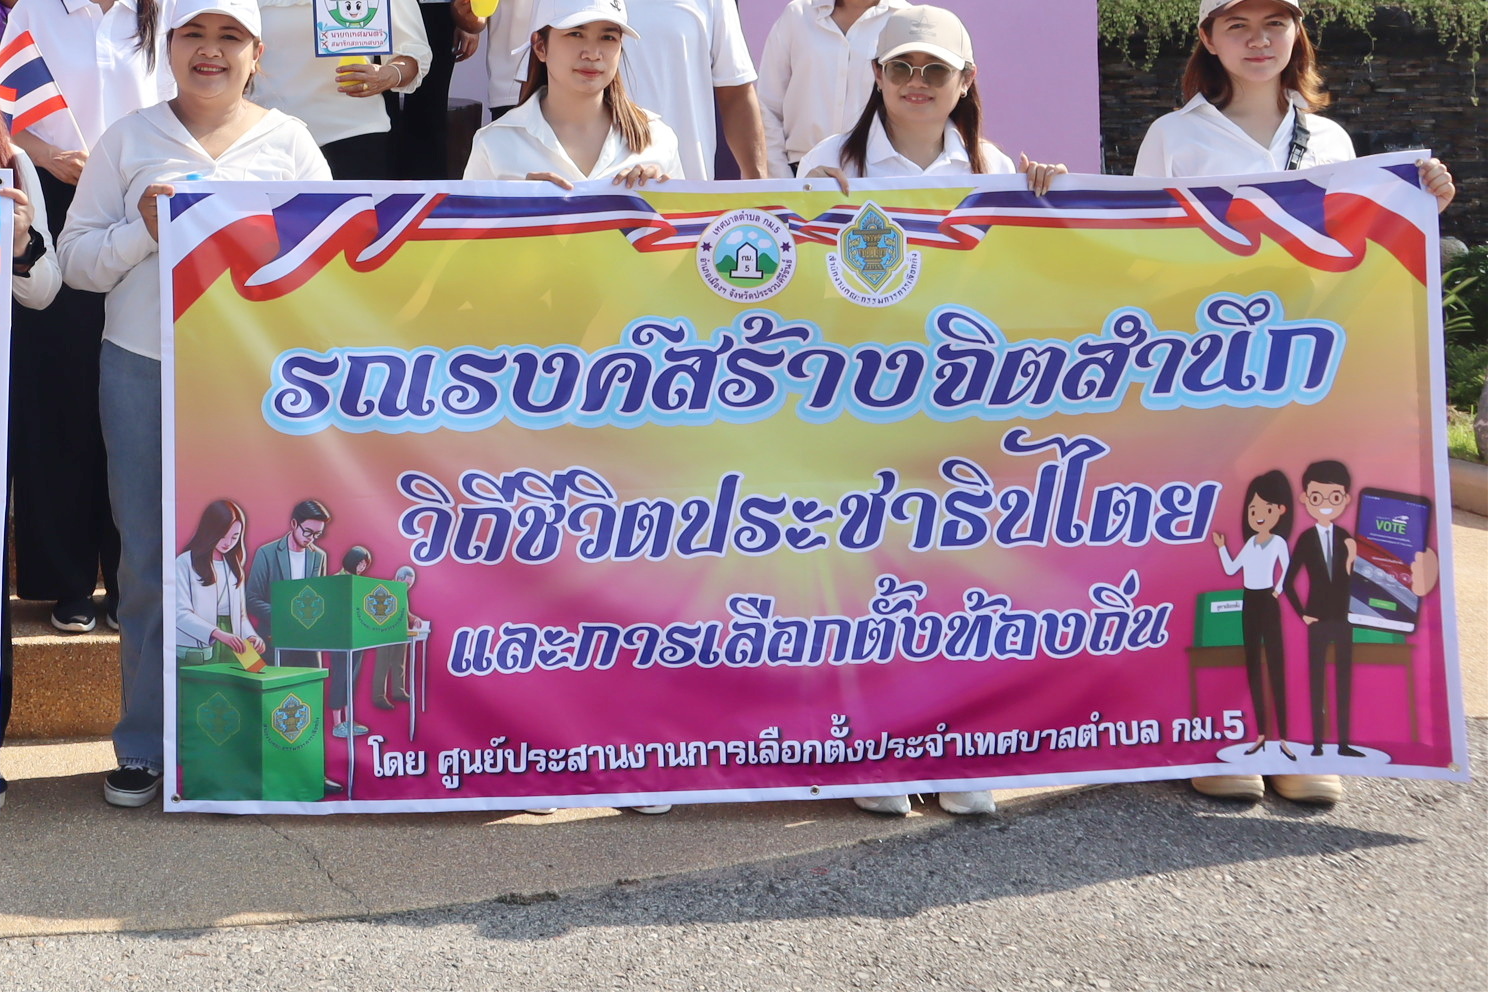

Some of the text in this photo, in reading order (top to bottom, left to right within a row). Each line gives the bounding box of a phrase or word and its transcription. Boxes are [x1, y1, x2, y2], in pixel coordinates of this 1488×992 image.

[712, 211, 781, 236] เทศบาลตำบล กม.5
[741, 254, 754, 262] กม.
[744, 264, 750, 272] 5
[274, 298, 1337, 419] รณรงค์สร้างจิตสำนึก
[1375, 519, 1407, 535] VOTE
[453, 570, 1168, 672] และการเลือกตั้งท้องถิ่น
[368, 709, 1245, 789] โดย ศูนย์ประสานงานการเลือกตั้งประจำเทศบาลตำบล กม.5
